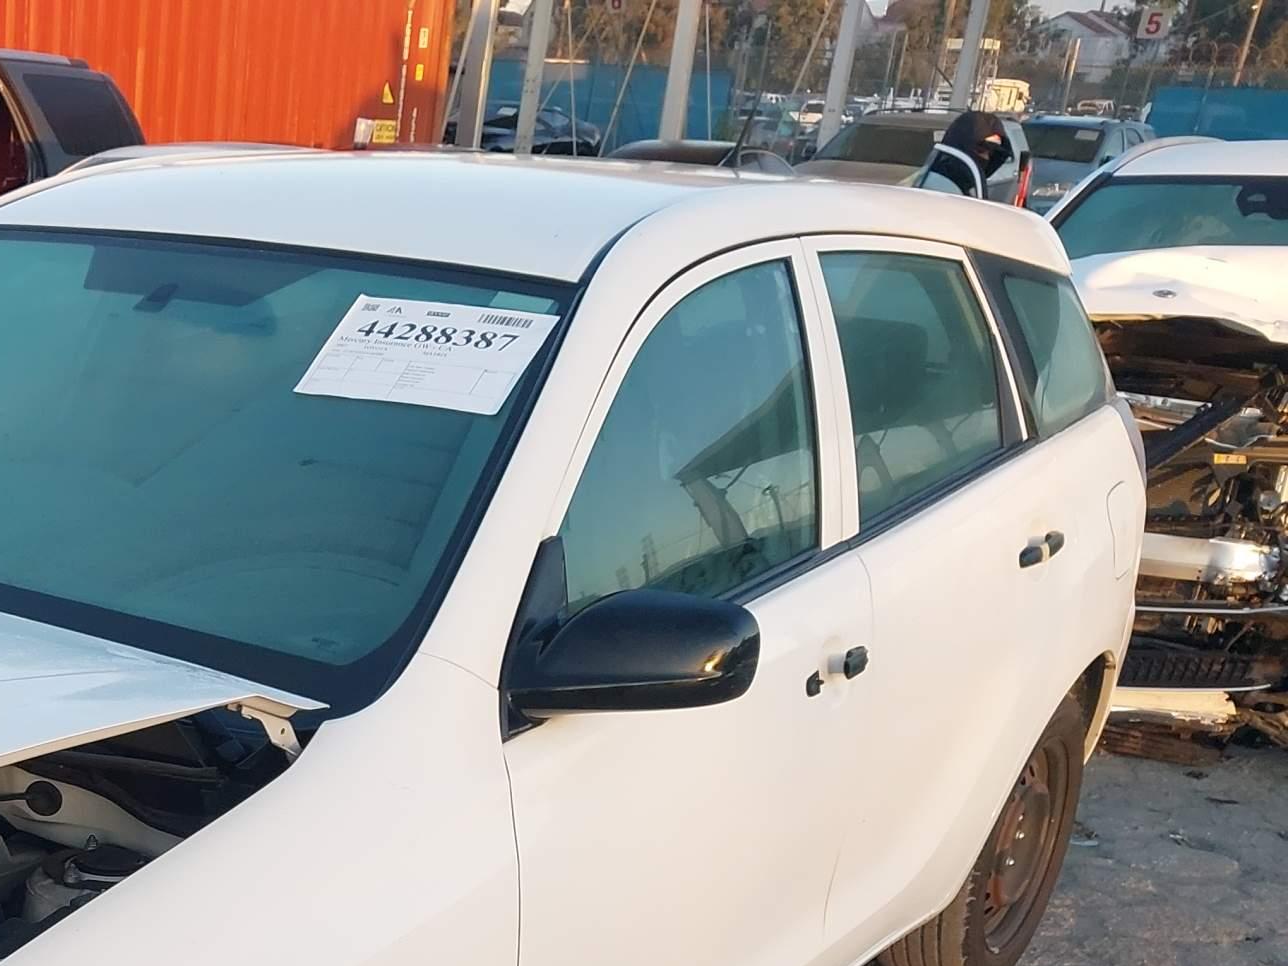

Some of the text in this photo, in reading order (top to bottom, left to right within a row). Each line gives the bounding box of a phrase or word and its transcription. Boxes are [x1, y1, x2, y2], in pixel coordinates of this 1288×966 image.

[1145, 13, 1163, 34] 5
[357, 319, 520, 351] 44288387
[374, 339, 411, 348] Insurance
